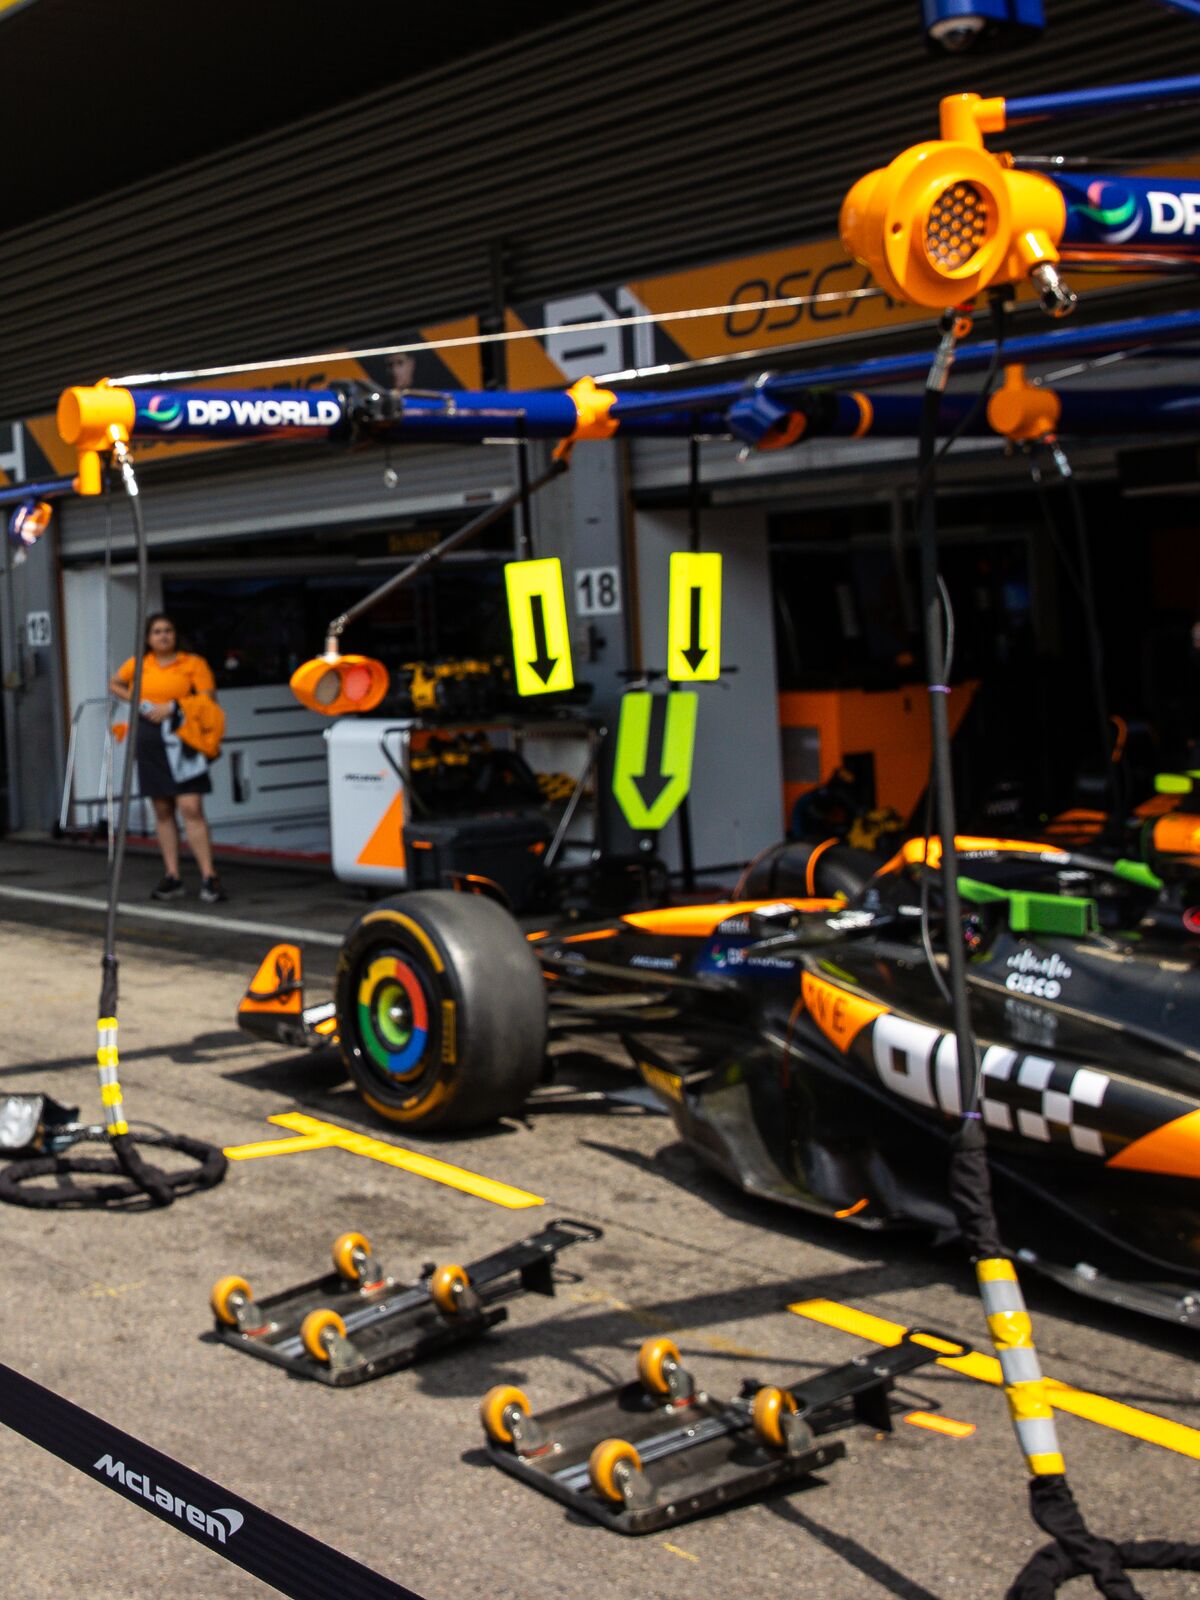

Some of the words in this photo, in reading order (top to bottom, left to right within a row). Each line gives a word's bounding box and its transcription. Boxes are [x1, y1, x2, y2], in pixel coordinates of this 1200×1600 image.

[725, 258, 906, 339] OSCA
[187, 399, 231, 426] DP
[231, 399, 341, 426] WORLD
[579, 573, 616, 608] 18
[92, 1453, 230, 1544] McLaren
